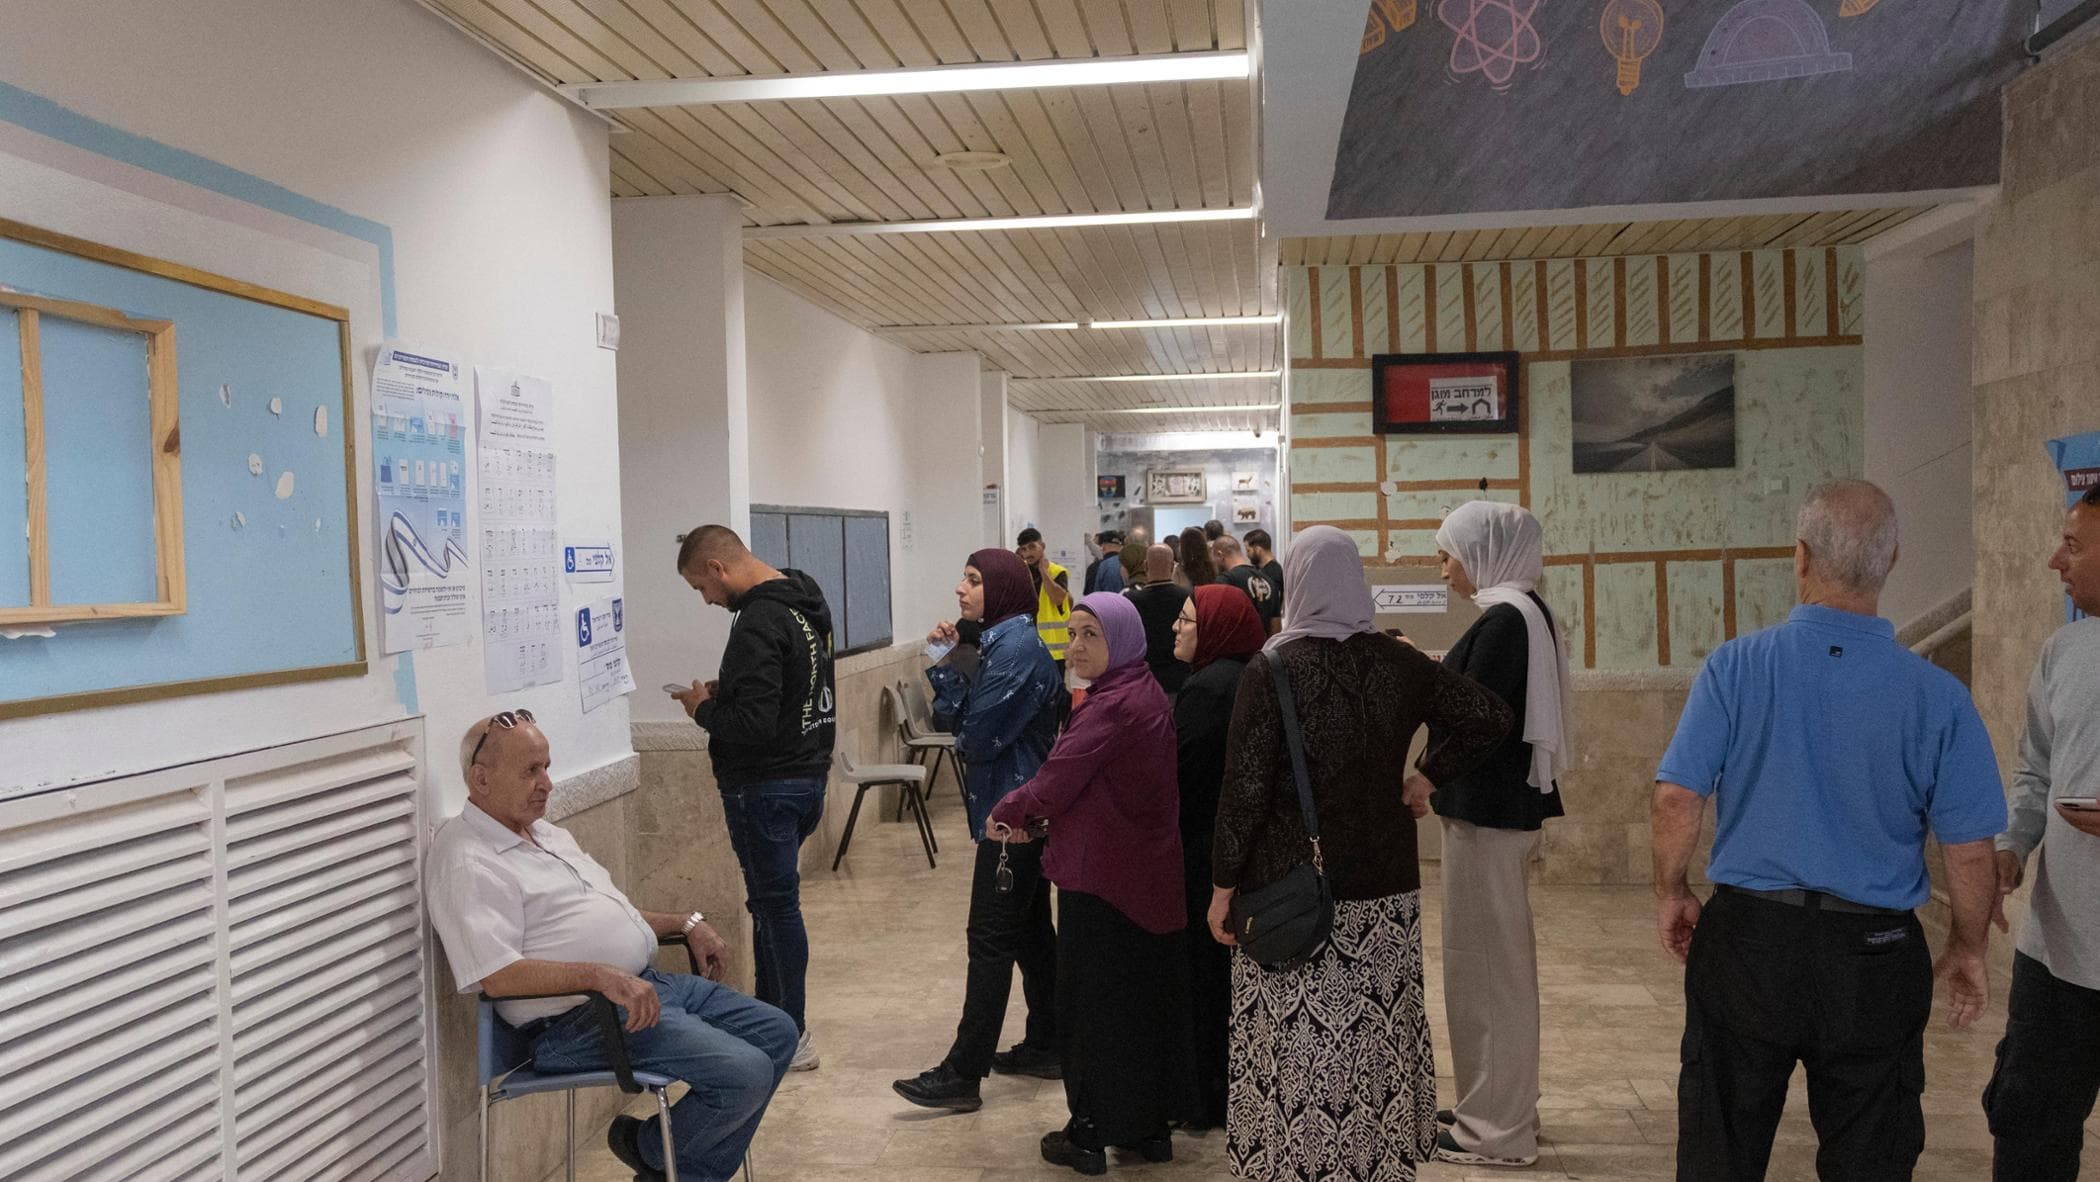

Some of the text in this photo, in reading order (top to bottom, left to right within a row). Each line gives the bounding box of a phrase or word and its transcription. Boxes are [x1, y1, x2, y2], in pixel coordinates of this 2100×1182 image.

[1431, 385, 1492, 401] למרחב מוגן
[802, 698, 813, 729] THE
[808, 643, 817, 696] ORTH
